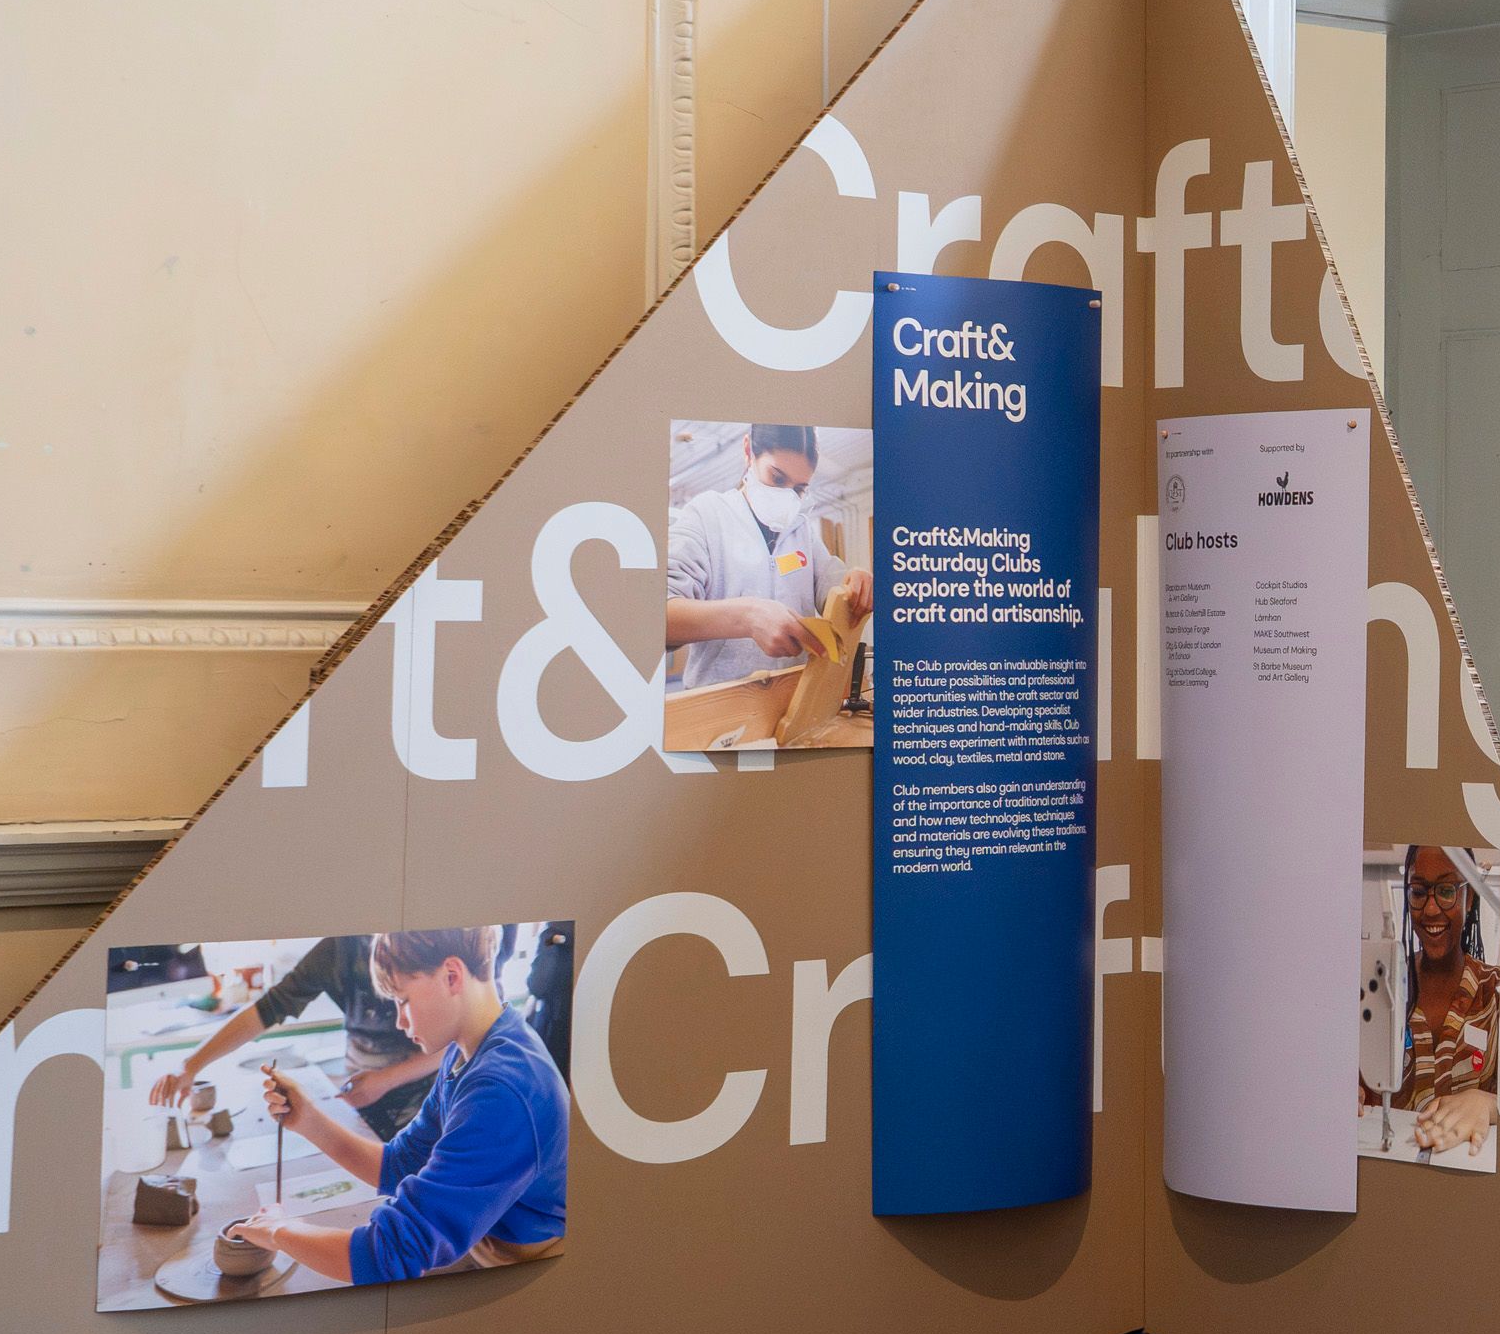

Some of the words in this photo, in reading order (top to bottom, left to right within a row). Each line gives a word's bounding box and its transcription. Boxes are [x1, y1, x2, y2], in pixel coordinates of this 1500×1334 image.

[692, 112, 1375, 389] Craft
[893, 317, 1016, 361] Craft&
[894, 369, 1027, 422] Making
[1260, 444, 1294, 453] Supported
[1296, 444, 1305, 452] by
[1258, 491, 1314, 506] HOWDENS
[893, 527, 1031, 553] Craft&Making
[1166, 532, 1193, 551] Club
[1197, 532, 1237, 548] hosts
[893, 552, 988, 577] Saturday
[992, 553, 1041, 573] Clubs
[893, 578, 969, 602] explore
[974, 578, 1004, 597] the
[1008, 579, 1053, 597] world
[1057, 579, 1071, 598] of
[1256, 582, 1281, 590] Cockpit
[893, 603, 946, 623] craft
[950, 604, 988, 623] and
[992, 605, 1083, 628] artisanship.
[1254, 630, 1272, 638] MAKE
[1274, 630, 1309, 638] Southwest
[1283, 646, 1289, 654] of
[1291, 646, 1317, 656] Making
[893, 661, 914, 671] The
[917, 661, 941, 671] Club
[945, 660, 987, 673] provides
[990, 662, 1002, 670] an
[1004, 660, 1048, 670] invaluable
[1050, 660, 1074, 672] insight
[1075, 661, 1086, 669] into
[893, 677, 912, 686] the
[915, 676, 947, 686] future
[950, 676, 1006, 688] possibilities
[1008, 676, 1026, 685] and
[1028, 675, 1074, 687] professional
[1284, 674, 1309, 683] Gallery
[893, 692, 966, 705] opportunities
[968, 691, 997, 701] within
[1000, 691, 1014, 700] the
[1017, 691, 1038, 700] craft
[1040, 690, 1063, 700] sector
[1066, 690, 1079, 699] and
[893, 707, 924, 718] wider
[927, 706, 979, 717] industries.
[982, 706, 1032, 718] Developing
[1035, 706, 1070, 717] specialist
[893, 723, 954, 735] techniques
[957, 722, 977, 732] and
[980, 721, 1042, 733] hand-making
[1044, 720, 1063, 731] skills,
[1064, 720, 1079, 730] Club
[893, 739, 947, 749] members
[950, 737, 1005, 750] experiment
[1008, 736, 1027, 746] with
[1029, 735, 1065, 745] materials
[1067, 735, 1082, 744] such
[1082, 736, 1089, 744] as
[893, 754, 927, 765] wood,
[930, 754, 954, 766] clay,
[957, 753, 994, 763] textiles,
[996, 752, 1022, 762] metal
[1024, 751, 1041, 761] and
[1043, 751, 1065, 761] stone.
[893, 785, 919, 795] Club
[923, 785, 974, 795] members
[976, 783, 997, 793] also
[999, 783, 1020, 795] gain
[1022, 783, 1033, 792] an
[1035, 780, 1085, 792] understanding
[893, 801, 905, 811] of
[908, 801, 927, 811] the
[929, 799, 990, 812] importance
[993, 799, 1003, 808] of
[1005, 797, 1049, 807] traditional
[1051, 796, 1068, 806] craft
[1070, 795, 1083, 804] skills
[893, 817, 916, 827] and
[919, 816, 943, 826] how
[945, 816, 966, 825] new
[970, 813, 1032, 825] technologies,
[1034, 811, 1074, 823] techniques
[893, 833, 916, 842] and
[919, 831, 970, 841] materials
[973, 830, 990, 839] are
[992, 829, 1030, 840] evolving
[1032, 826, 1054, 836] these
[893, 847, 942, 859] ensuring
[946, 845, 969, 858] they
[972, 844, 1006, 854] remain
[1009, 842, 1043, 853] relevant
[1046, 842, 1053, 851] in
[1054, 841, 1066, 851] the
[893, 862, 938, 874] modern
[941, 861, 972, 871] world.
